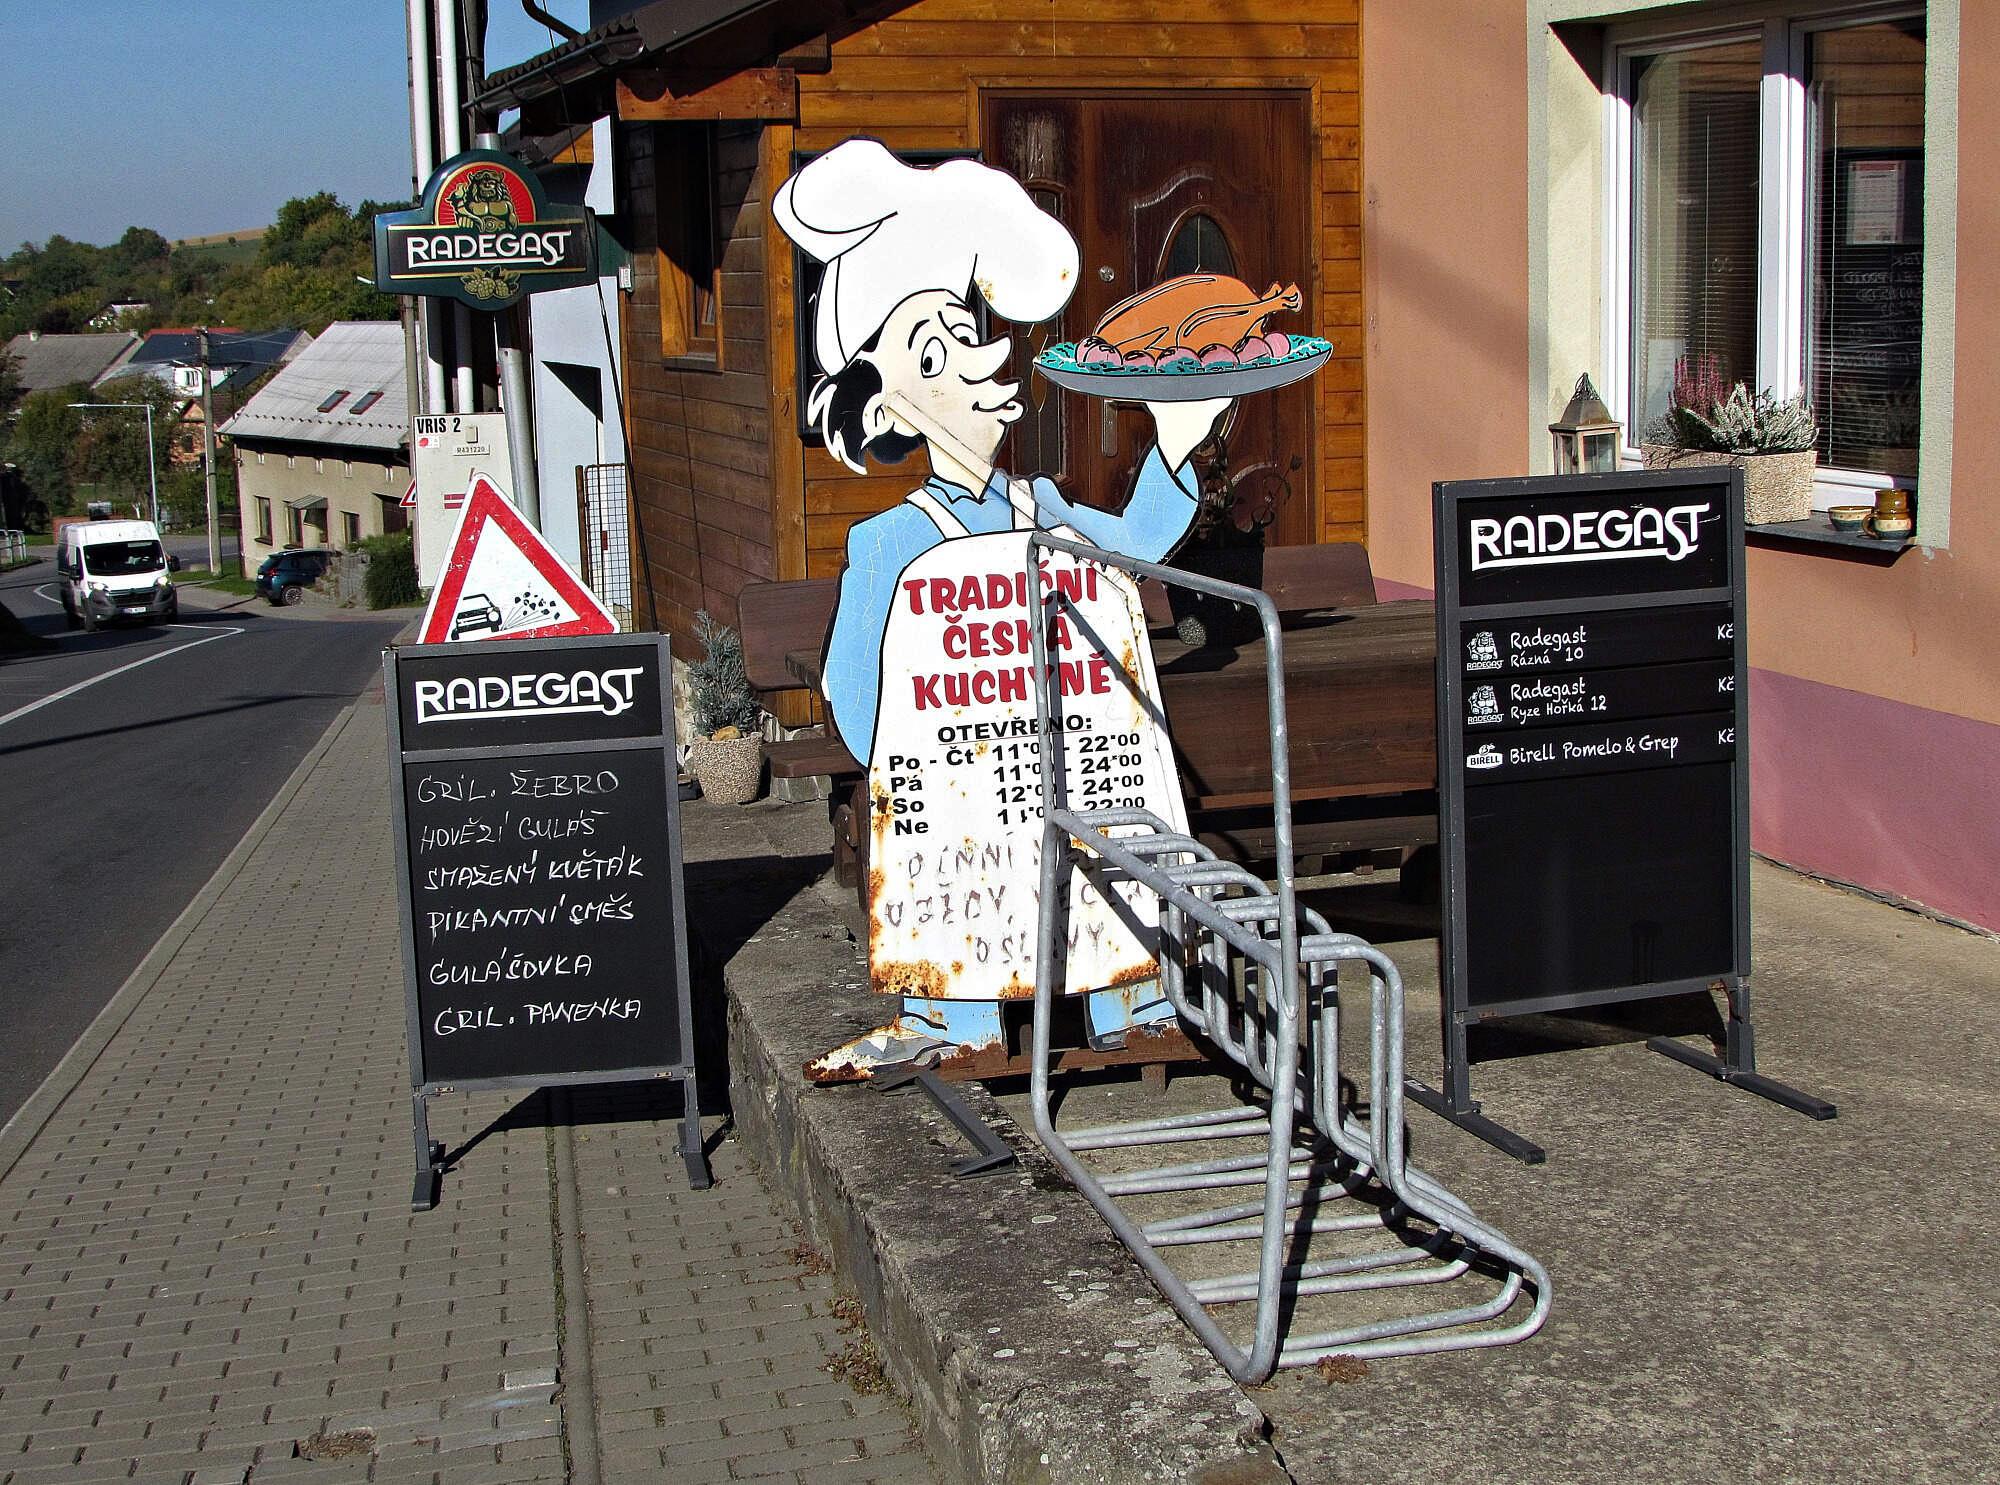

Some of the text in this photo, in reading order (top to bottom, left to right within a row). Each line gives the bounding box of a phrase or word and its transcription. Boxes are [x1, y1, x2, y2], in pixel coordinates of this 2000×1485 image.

[407, 230, 571, 268] RADEGAST
[417, 417, 461, 433] VRIS 2
[1470, 502, 1709, 571] RADEGAST
[943, 607, 1072, 659] ČESKÁ
[1510, 623, 1733, 651] Radegast Kč
[1467, 660, 1504, 671] RADEGAST
[1511, 646, 1584, 667] Rázná 10
[415, 666, 643, 725] RADEGAST
[1510, 676, 1734, 703] Radegast Kč
[1468, 714, 1504, 725] RADEGAST
[1511, 694, 1607, 724] Ryze Hořká 12
[889, 755, 920, 771] Po
[946, 746, 974, 765] Čt
[1510, 743, 1555, 764] Birell
[1563, 737, 1622, 759] Pomelo
[1639, 735, 1679, 759] Grep
[1718, 728, 1734, 744] Kč
[1470, 755, 1500, 766] BIRELL
[510, 770, 619, 798] ŽEBRO
[891, 775, 922, 793] Pá
[892, 798, 924, 814] So
[420, 809, 610, 854] HOVĚZÍ GULÁŠ
[894, 819, 928, 836] Ne
[424, 845, 644, 890] SMAŽENÝ KVĚTÁK
[427, 894, 566, 945] PIKANTNÍ
[429, 947, 592, 985] GULÁŠOVKA
[523, 998, 641, 1025] PANENKA
